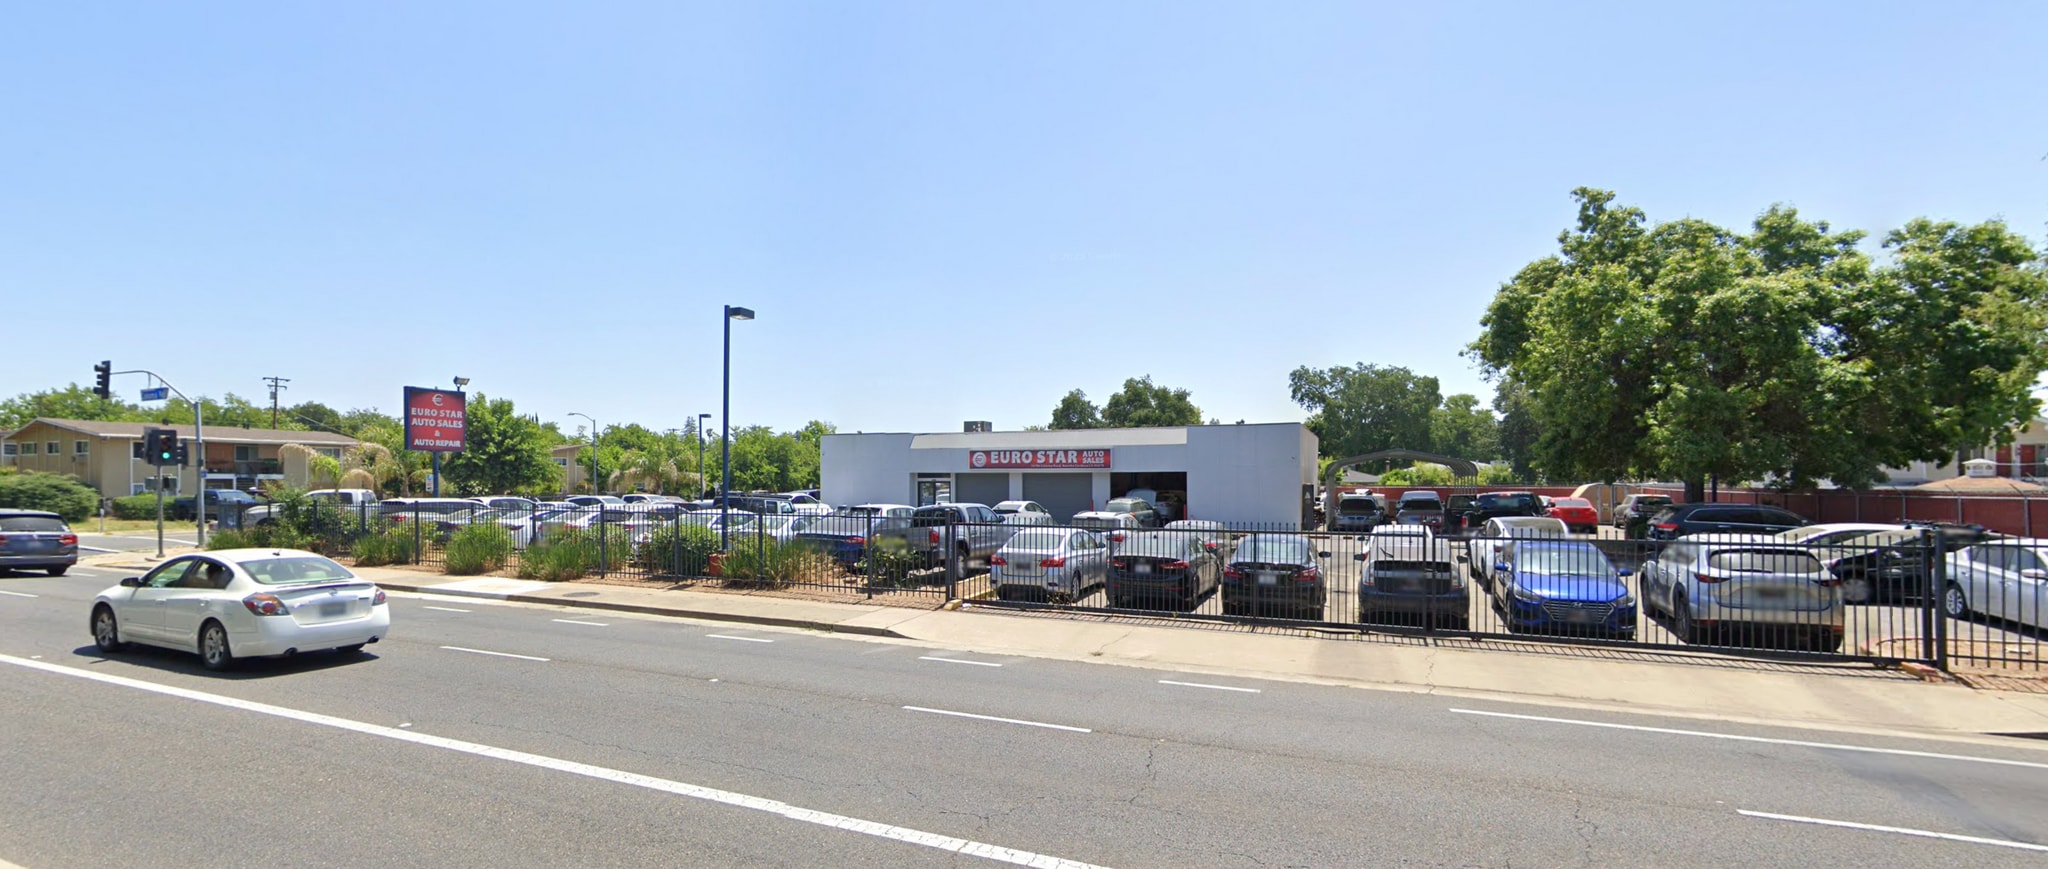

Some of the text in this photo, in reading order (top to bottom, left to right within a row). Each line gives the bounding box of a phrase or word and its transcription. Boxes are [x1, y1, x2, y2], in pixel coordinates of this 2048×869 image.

[411, 408, 462, 418] EURO STAR
[412, 418, 463, 428] AUTO SALES
[990, 450, 1078, 464] EURO STAR
[1082, 450, 1105, 458] AUTO
